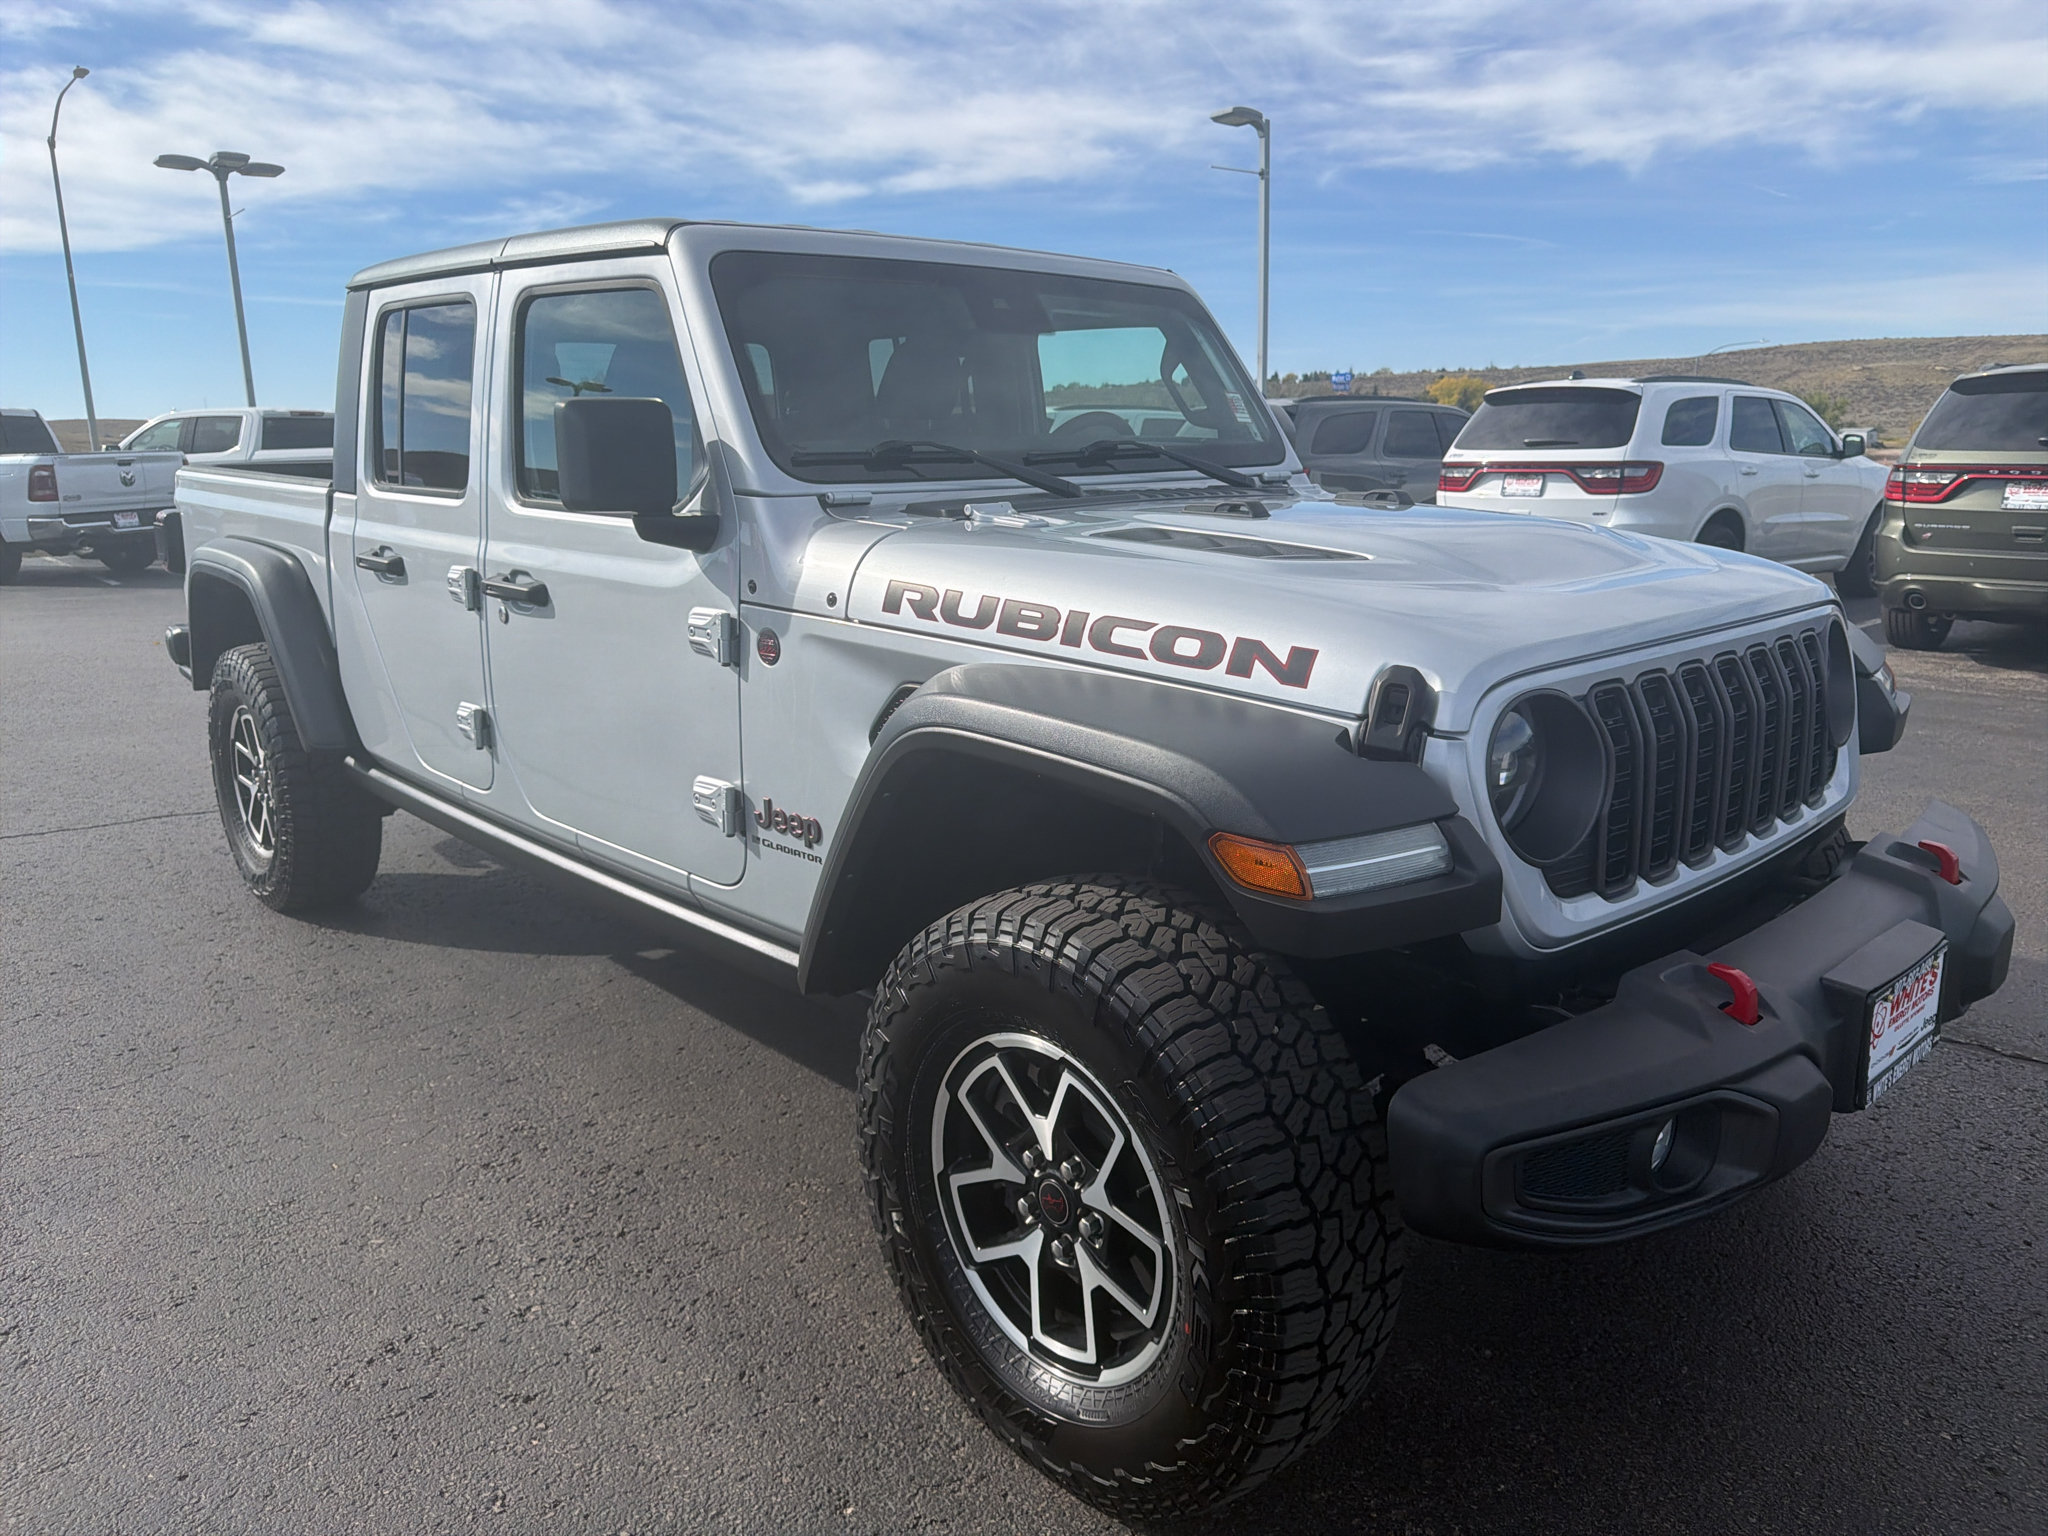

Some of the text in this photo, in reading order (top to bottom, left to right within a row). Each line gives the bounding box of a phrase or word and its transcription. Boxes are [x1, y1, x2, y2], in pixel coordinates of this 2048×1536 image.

[881, 579, 1319, 689] RUBICON
[753, 796, 823, 849] Jeep
[762, 838, 823, 865] GLADIATOR
[1888, 986, 1935, 1029] ENERGY MOTORS
[1889, 968, 1939, 1017] WHITE'S
[1920, 1013, 1938, 1032] Jeep
